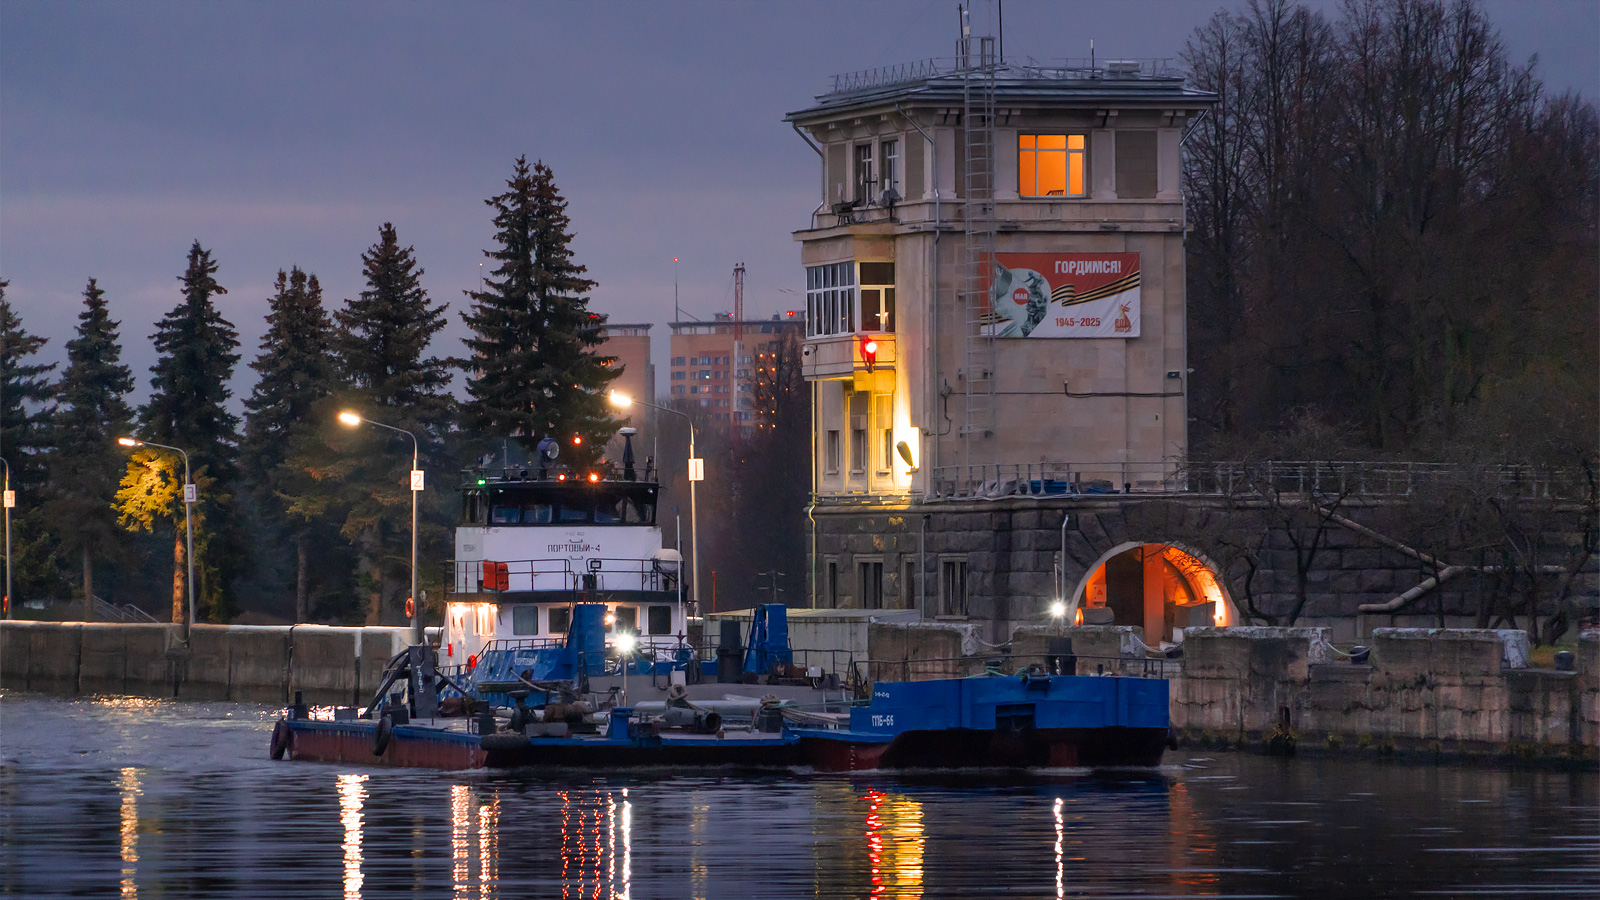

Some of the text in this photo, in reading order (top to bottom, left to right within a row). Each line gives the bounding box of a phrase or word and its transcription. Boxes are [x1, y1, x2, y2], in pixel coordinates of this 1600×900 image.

[1055, 261, 1121, 275] ГОРДИМСЯ!
[413, 473, 422, 488] 2
[6, 492, 13, 505] 4
[186, 486, 194, 500] 3
